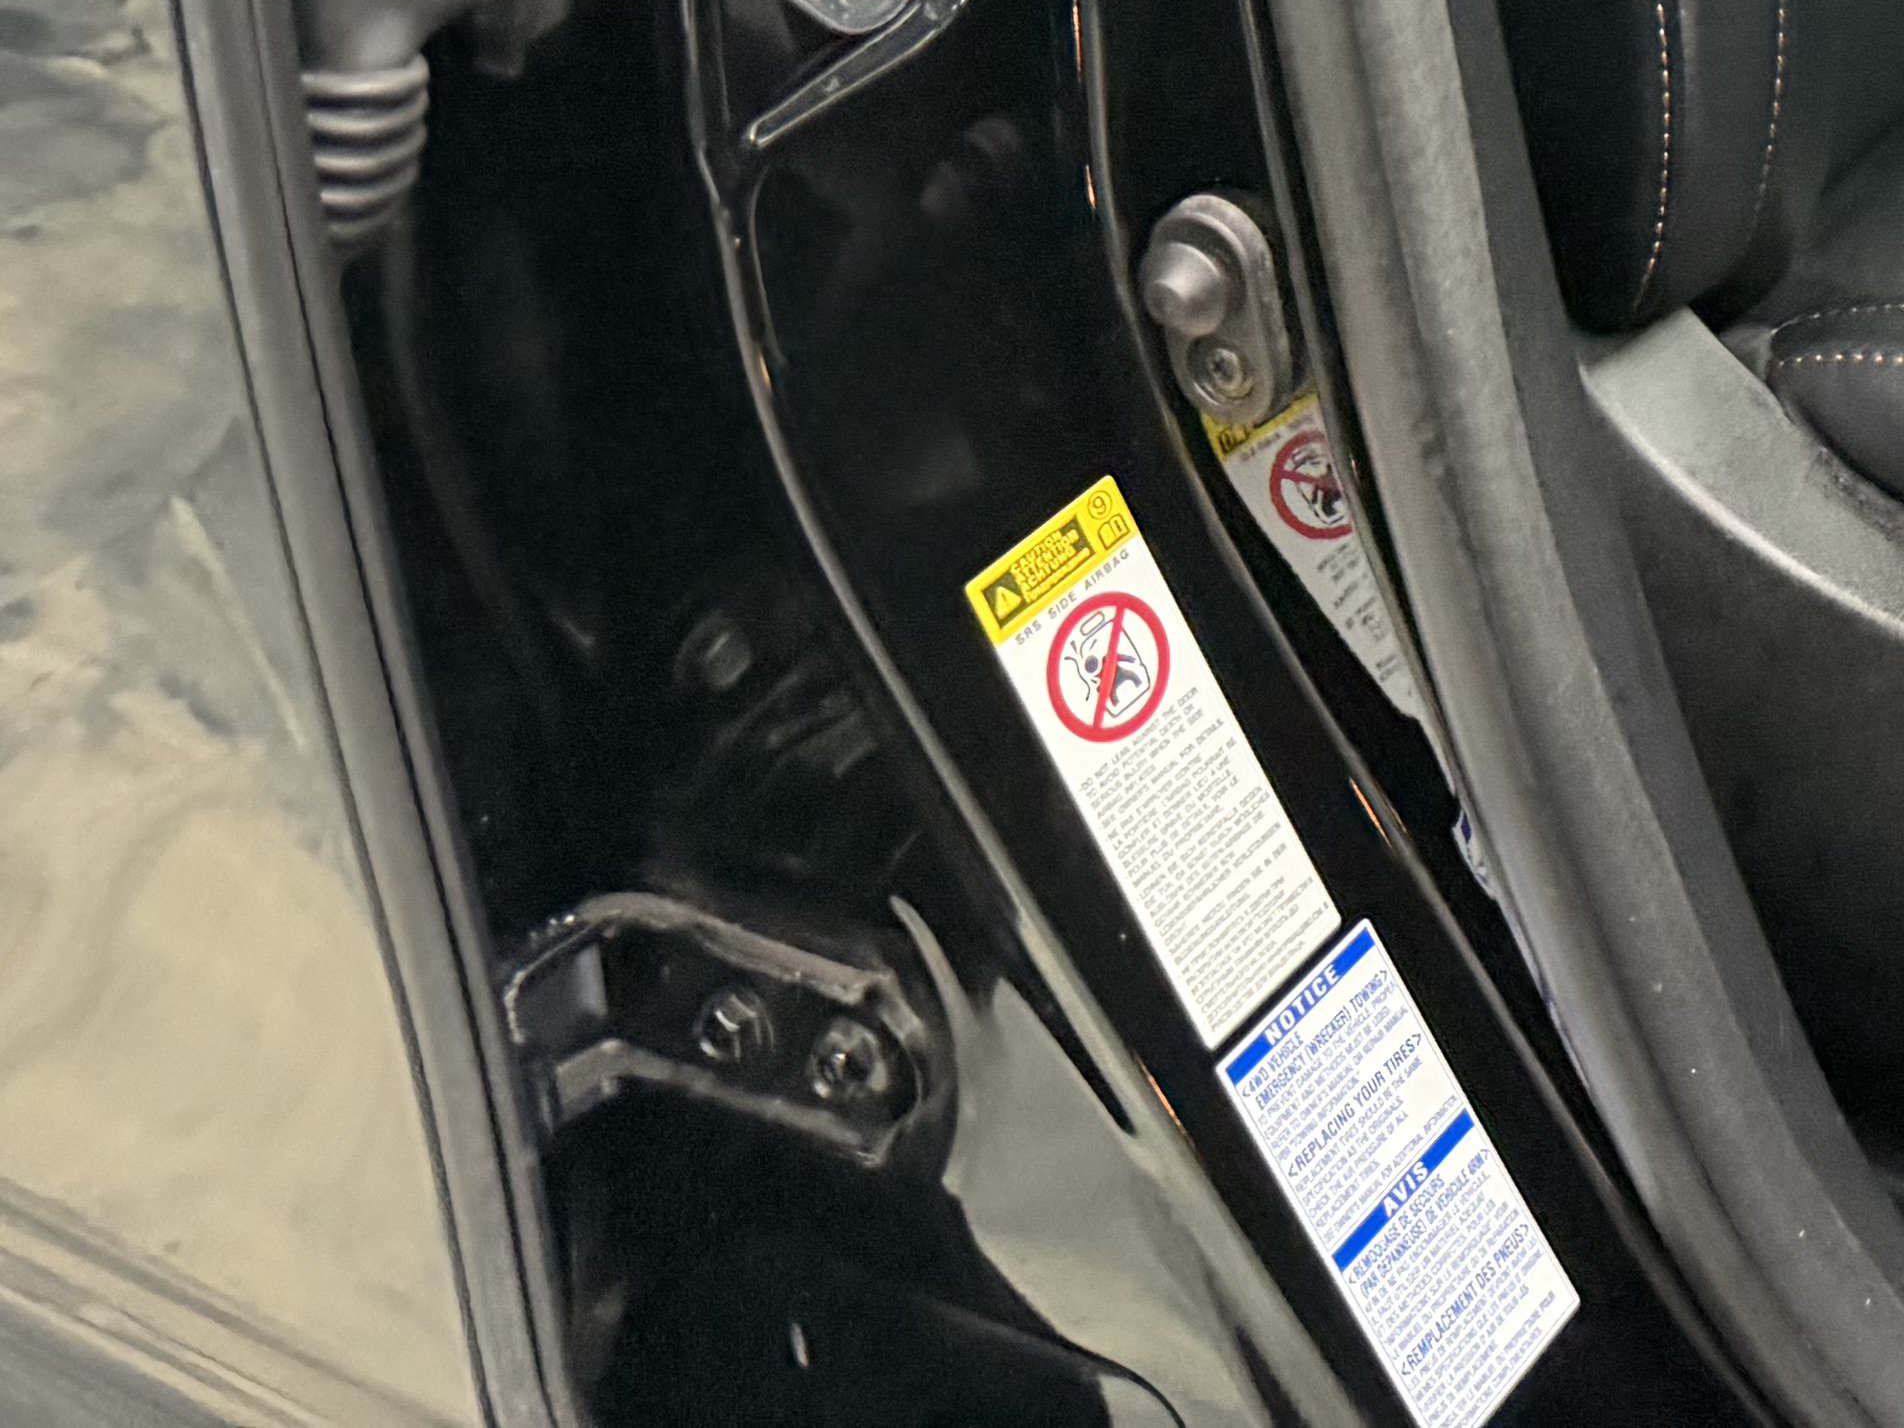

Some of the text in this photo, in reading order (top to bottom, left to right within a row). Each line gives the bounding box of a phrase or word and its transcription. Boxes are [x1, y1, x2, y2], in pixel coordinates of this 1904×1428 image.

[1008, 528, 1063, 576] CAUTION
[1013, 528, 1079, 585] ATTENTION
[1019, 543, 1076, 594] ACHTUNG
[1014, 618, 1042, 646] SRS
[1046, 589, 1078, 621] SIDE
[1082, 547, 1131, 592] AIRBAG
[1263, 963, 1340, 1047] NOTICE
[1254, 1051, 1307, 1110] EMERGENCY
[1303, 1005, 1352, 1060] (WRECKER)
[1266, 1030, 1304, 1073] VEHICLE
[1352, 1068, 1386, 1110] YOUR
[1380, 1158, 1429, 1218] AVIS
[1474, 1259, 1496, 1289] DES
